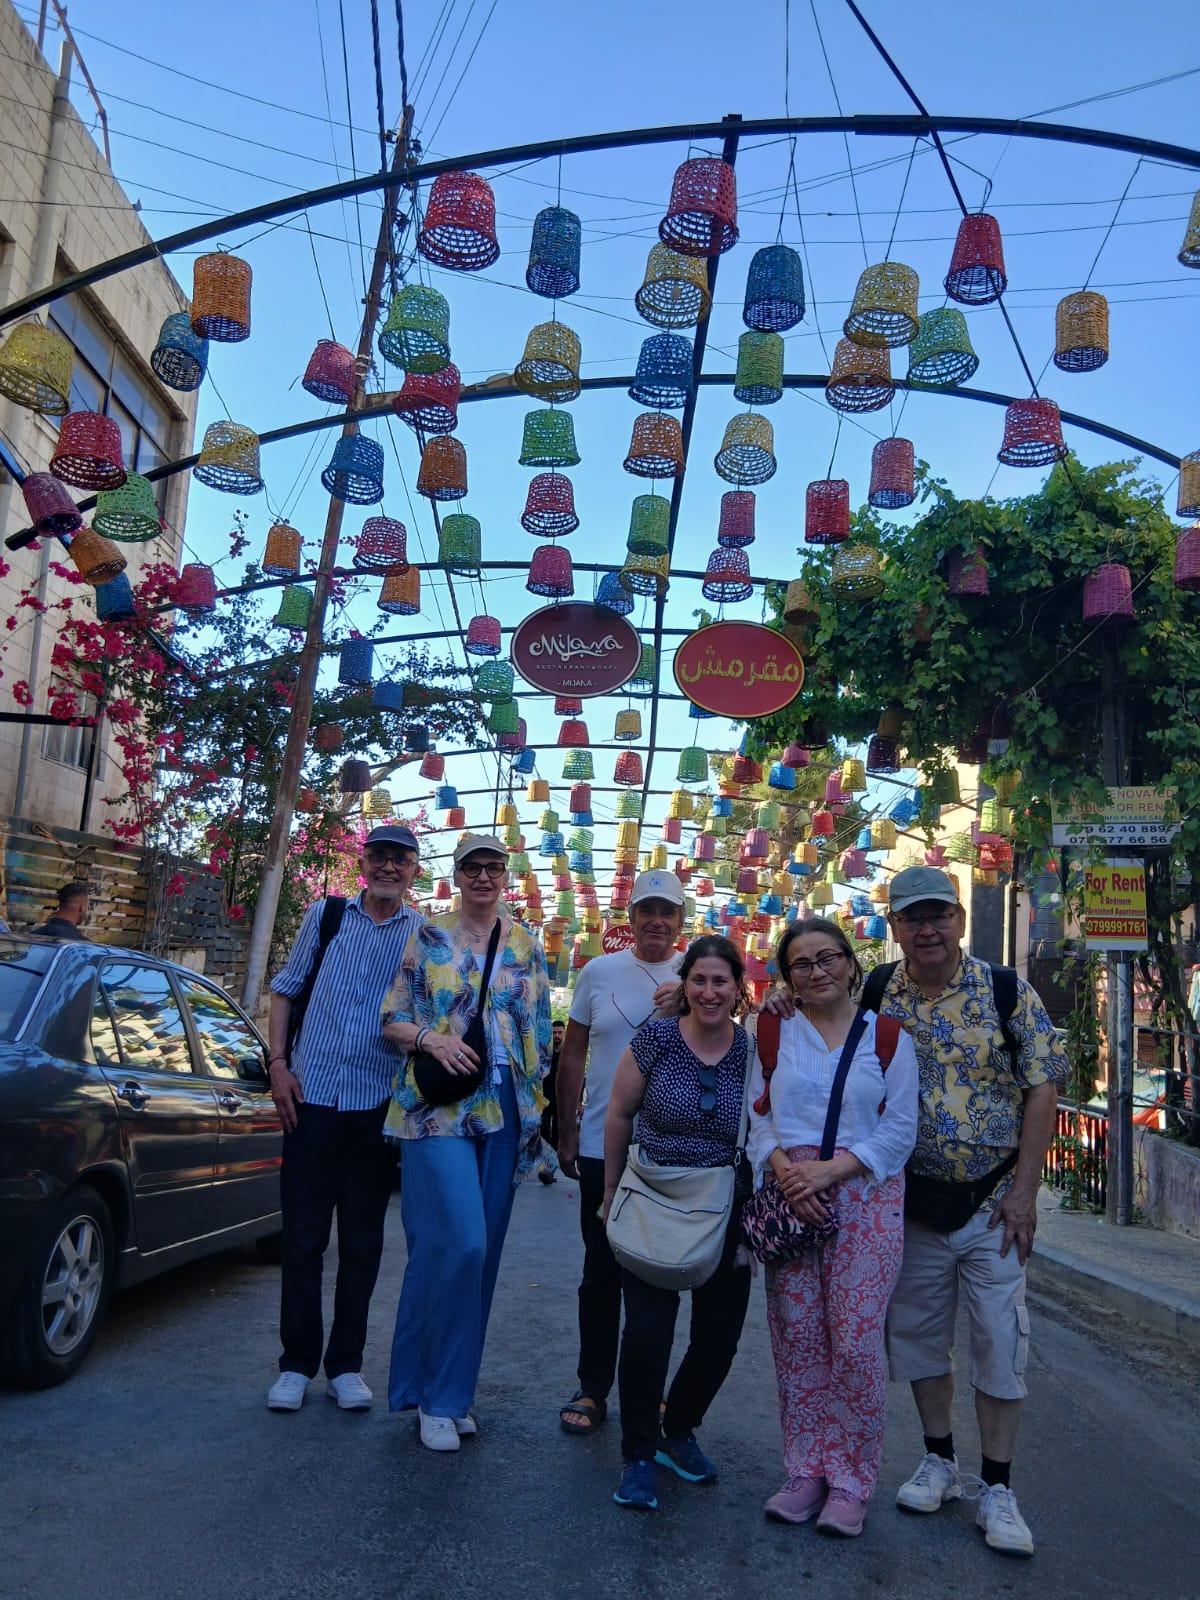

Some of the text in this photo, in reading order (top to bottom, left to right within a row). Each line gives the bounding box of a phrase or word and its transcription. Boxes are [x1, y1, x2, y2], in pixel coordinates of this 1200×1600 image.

[529, 634, 624, 662] Mijana
[680, 644, 800, 687] مقرمش
[562, 679, 593, 687] MIJANA
[1105, 789, 1174, 798] ENOVATD
[1109, 803, 1134, 812] FOR
[1138, 803, 1166, 812] REN
[1098, 825, 1115, 833] 62
[1119, 825, 1136, 833] 40
[1129, 836, 1145, 844] 66
[1151, 836, 1168, 844] 56
[1085, 872, 1145, 892] For Rent
[1105, 896, 1132, 905] Bedroom
[1114, 907, 1146, 917] Apartment
[1087, 920, 1146, 933] 0799991761
